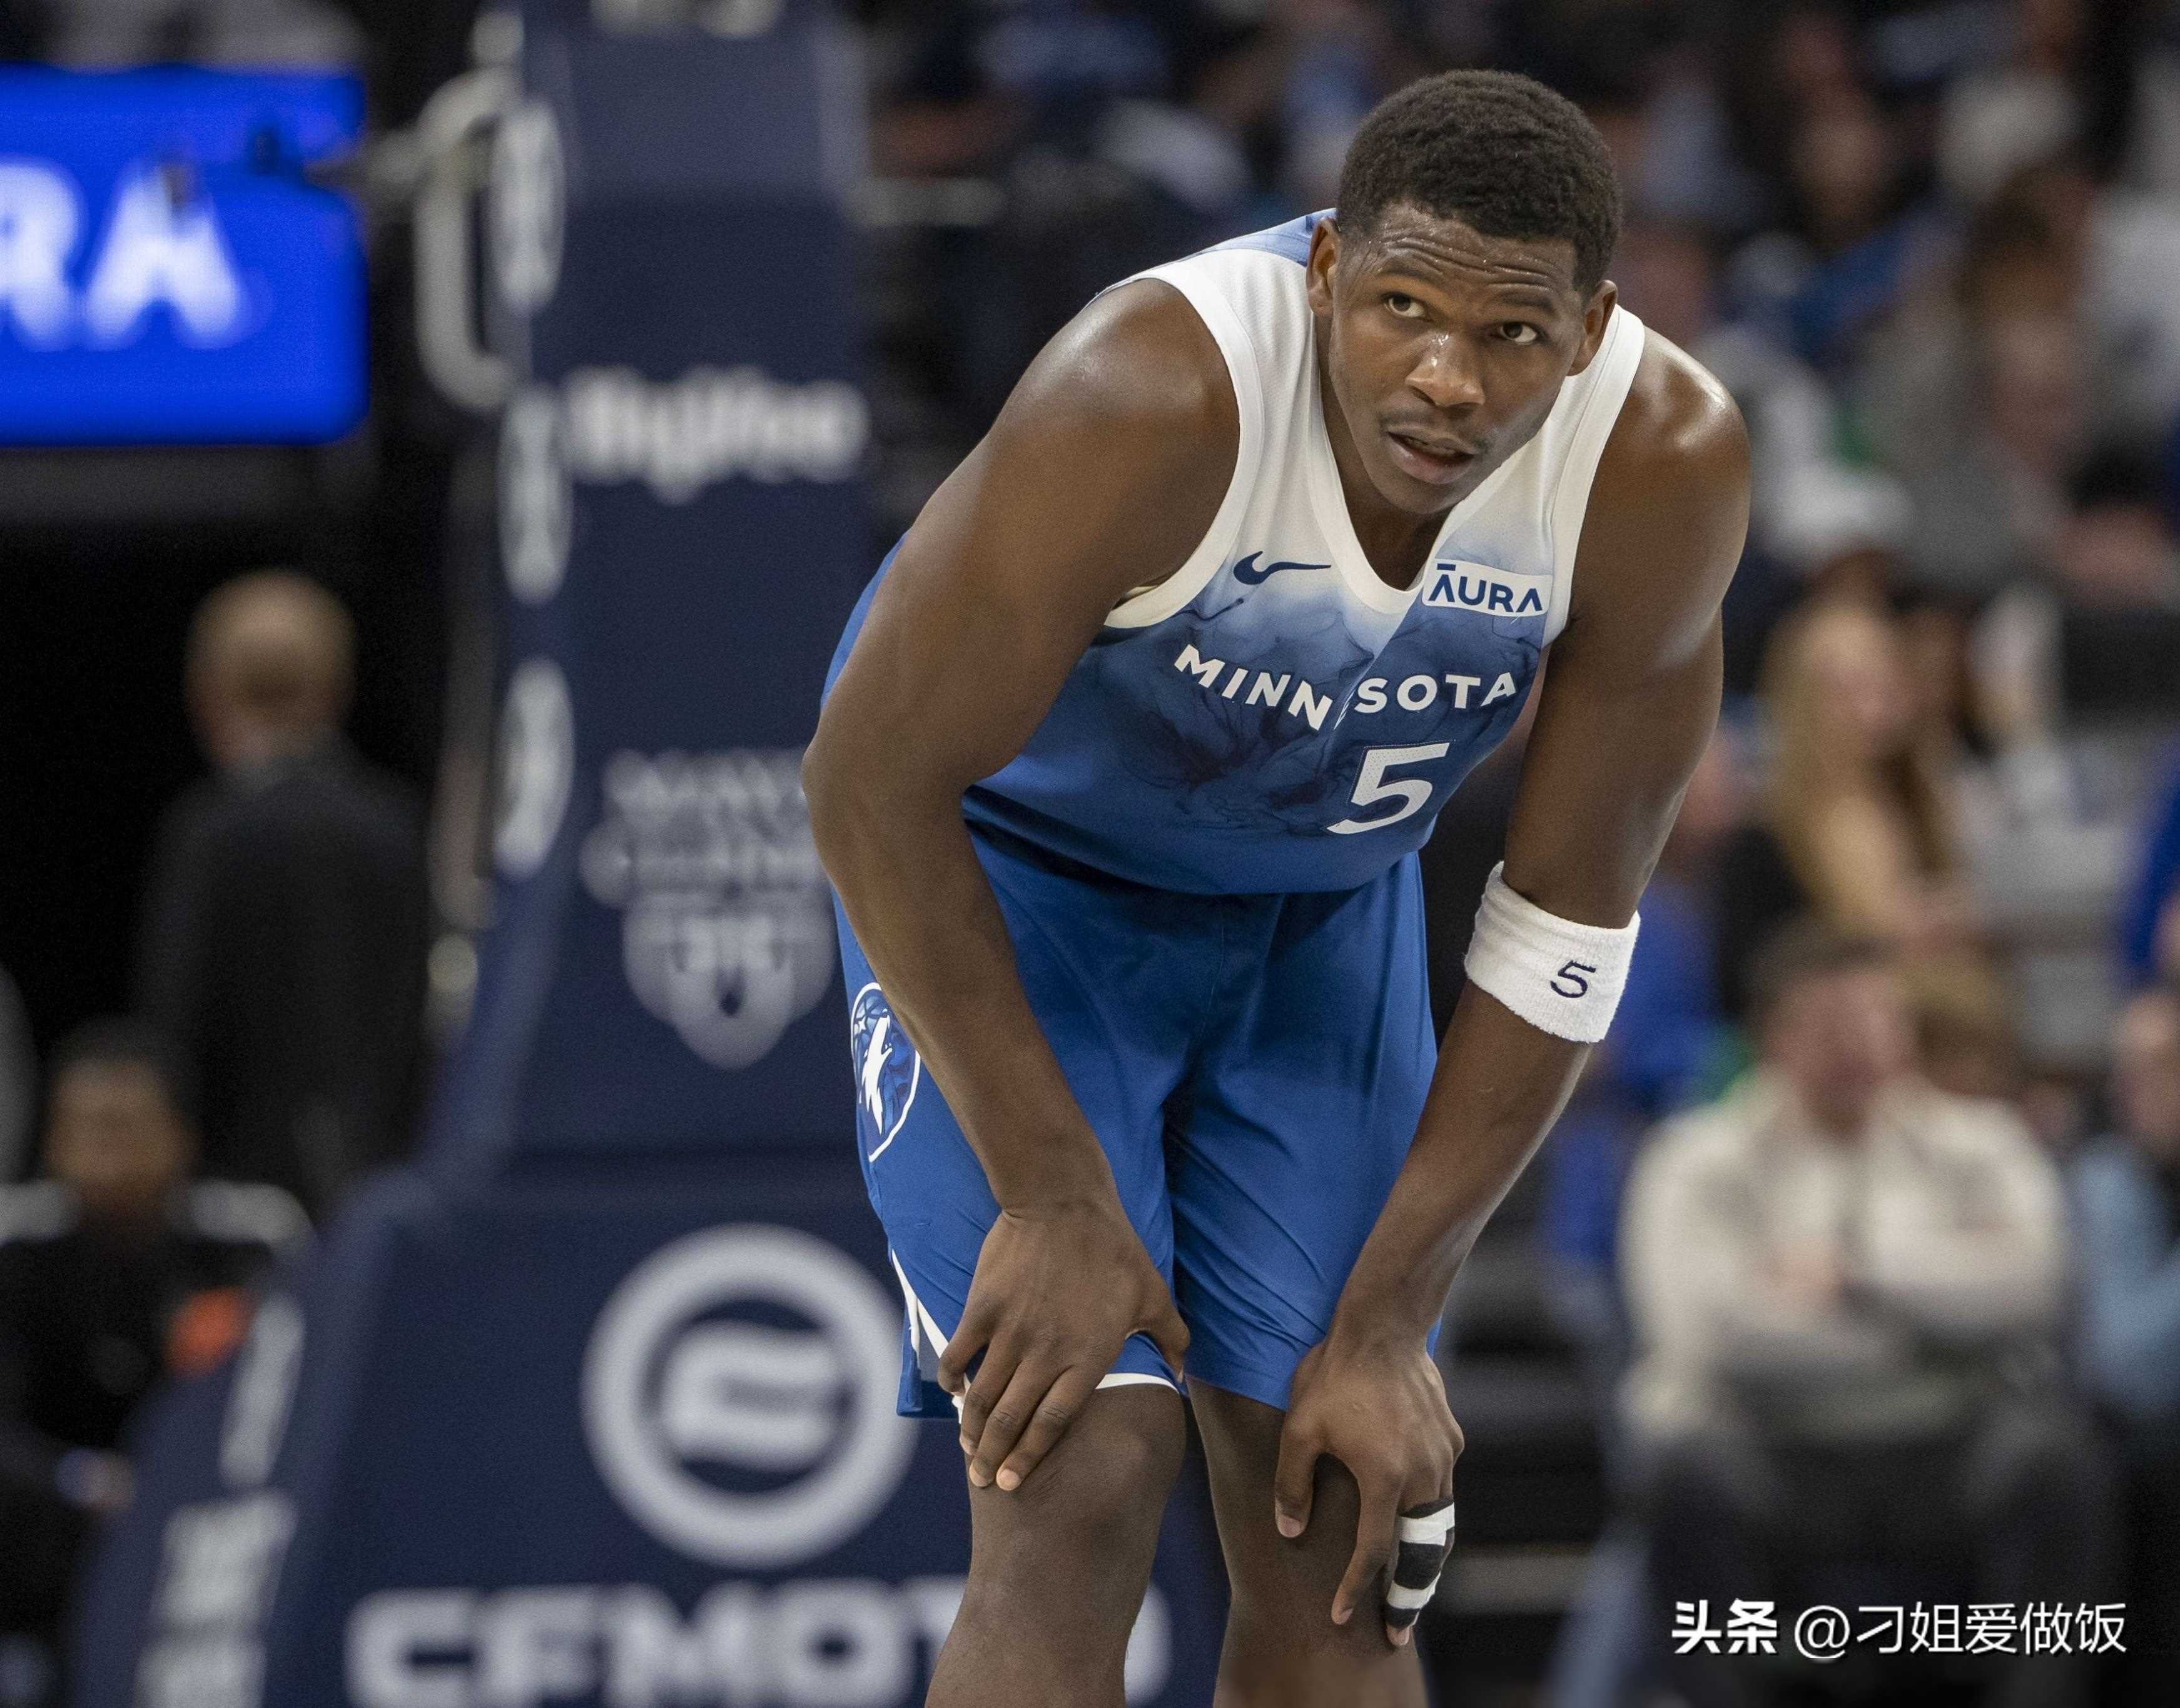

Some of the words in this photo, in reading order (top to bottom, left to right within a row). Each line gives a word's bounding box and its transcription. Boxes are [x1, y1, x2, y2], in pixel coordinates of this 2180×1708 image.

[1174, 644, 1517, 730] MINNSOTA
[1326, 742, 1450, 834] 5
[1549, 959, 1596, 999] 5
